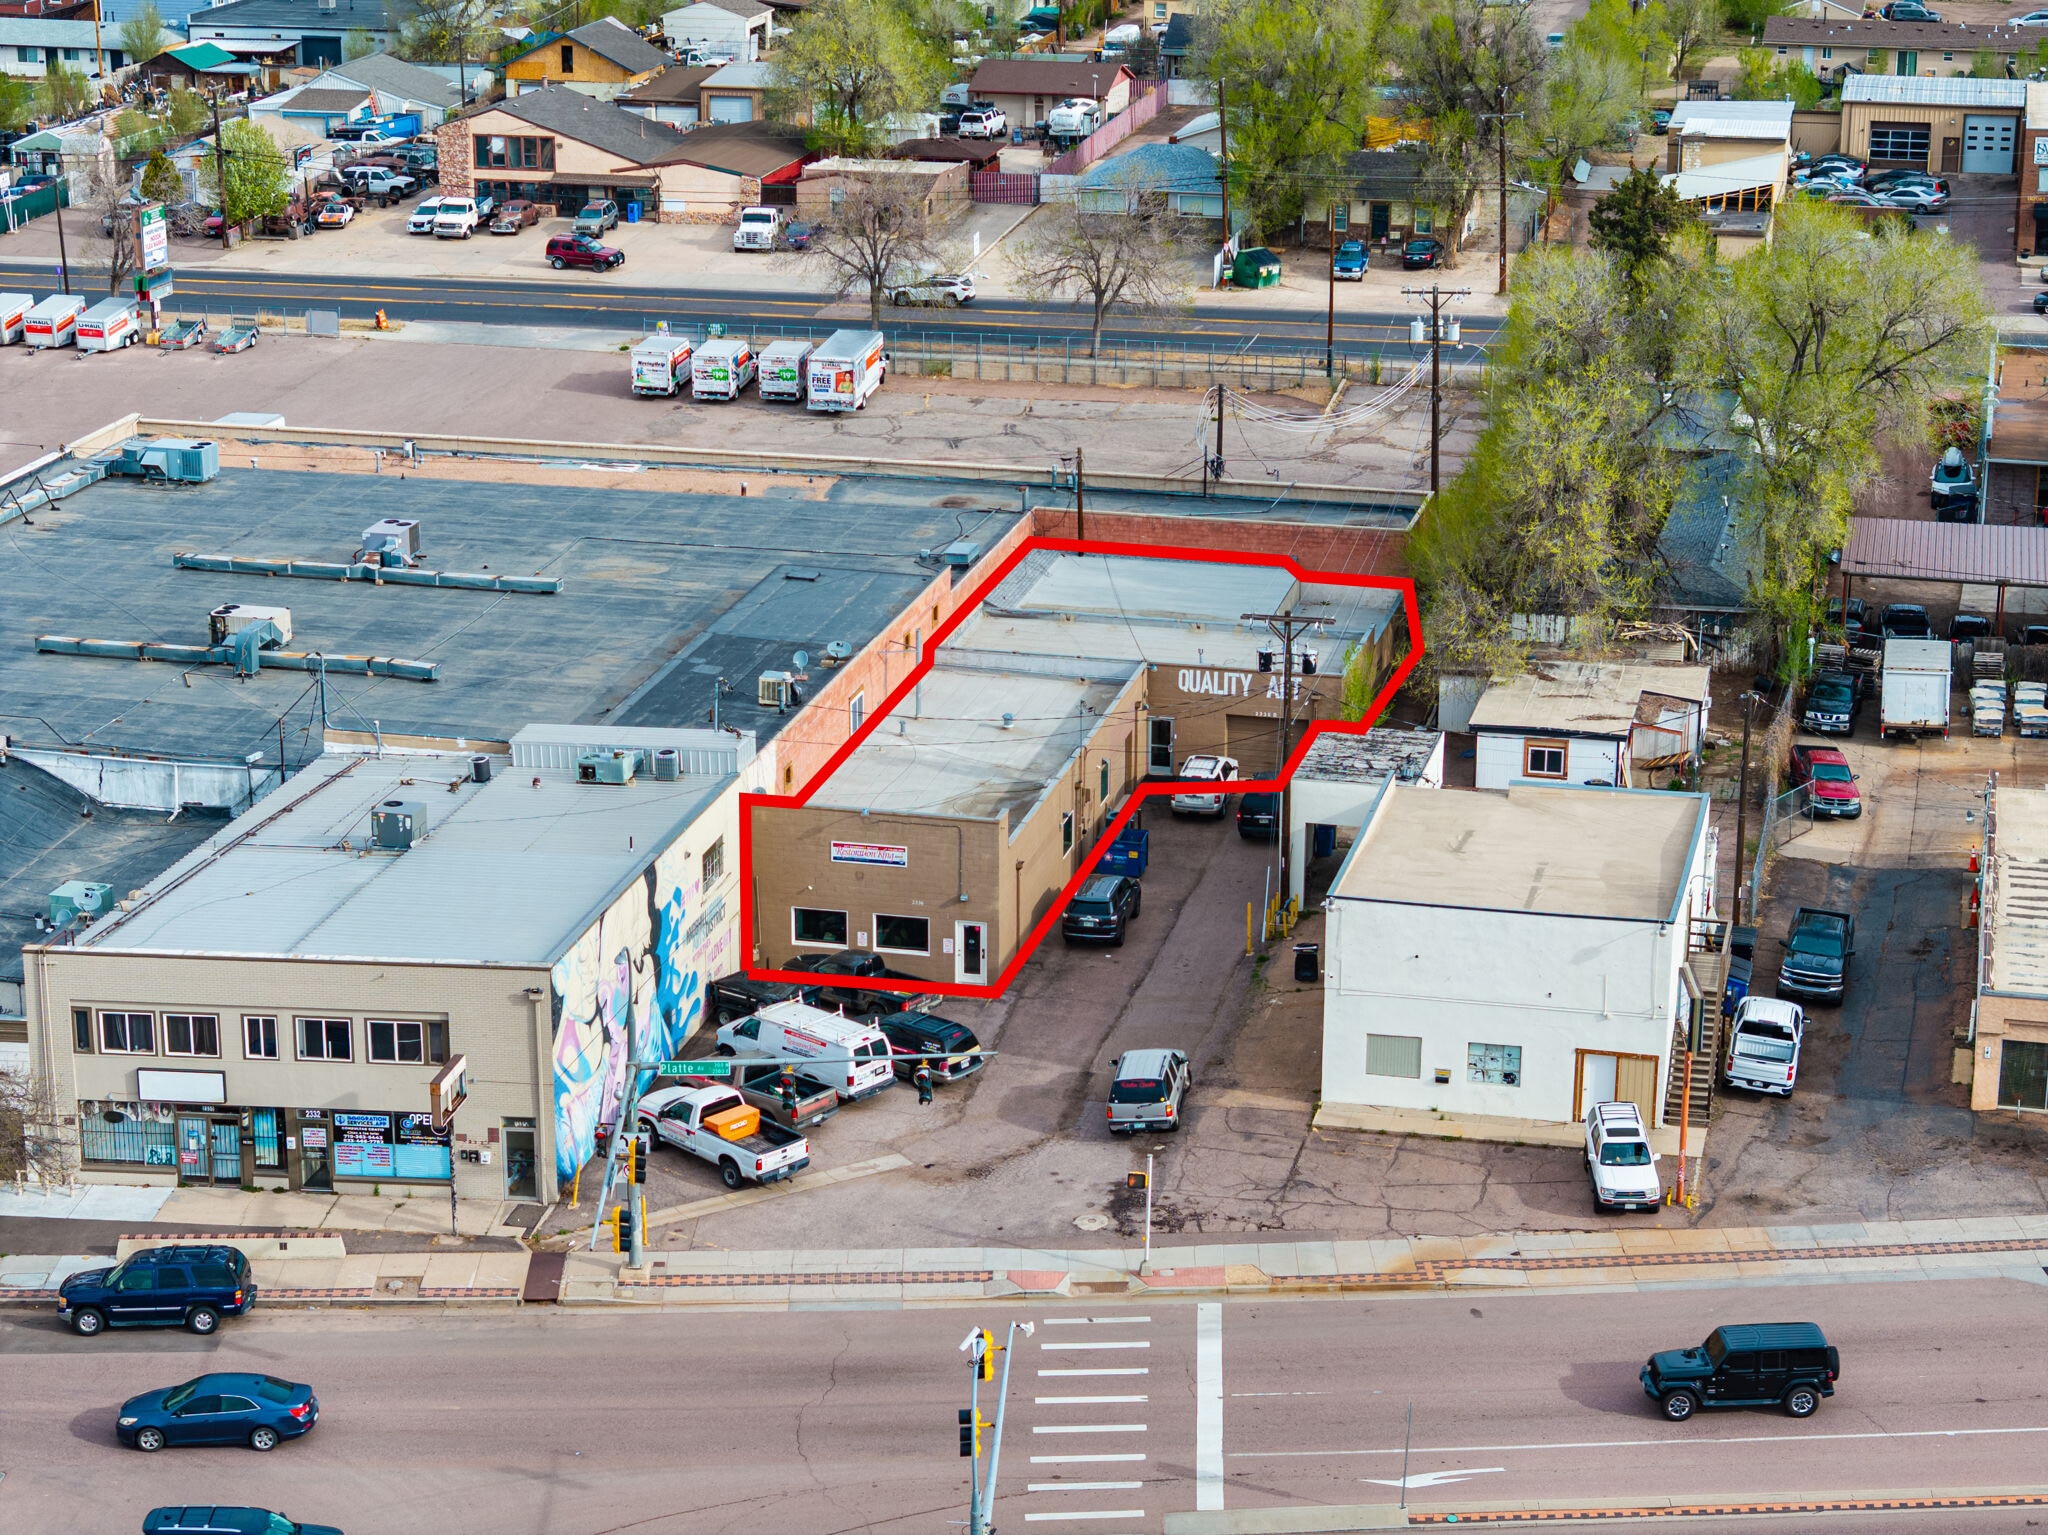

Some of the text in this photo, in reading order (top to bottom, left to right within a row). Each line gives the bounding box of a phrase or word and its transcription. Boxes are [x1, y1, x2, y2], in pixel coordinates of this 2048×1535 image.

[812, 377, 832, 385] FREE
[1178, 669, 1253, 697] QUALITY
[661, 1063, 694, 1074] Platte
[305, 1110, 321, 1118] 2332
[409, 1113, 433, 1126] OPE
